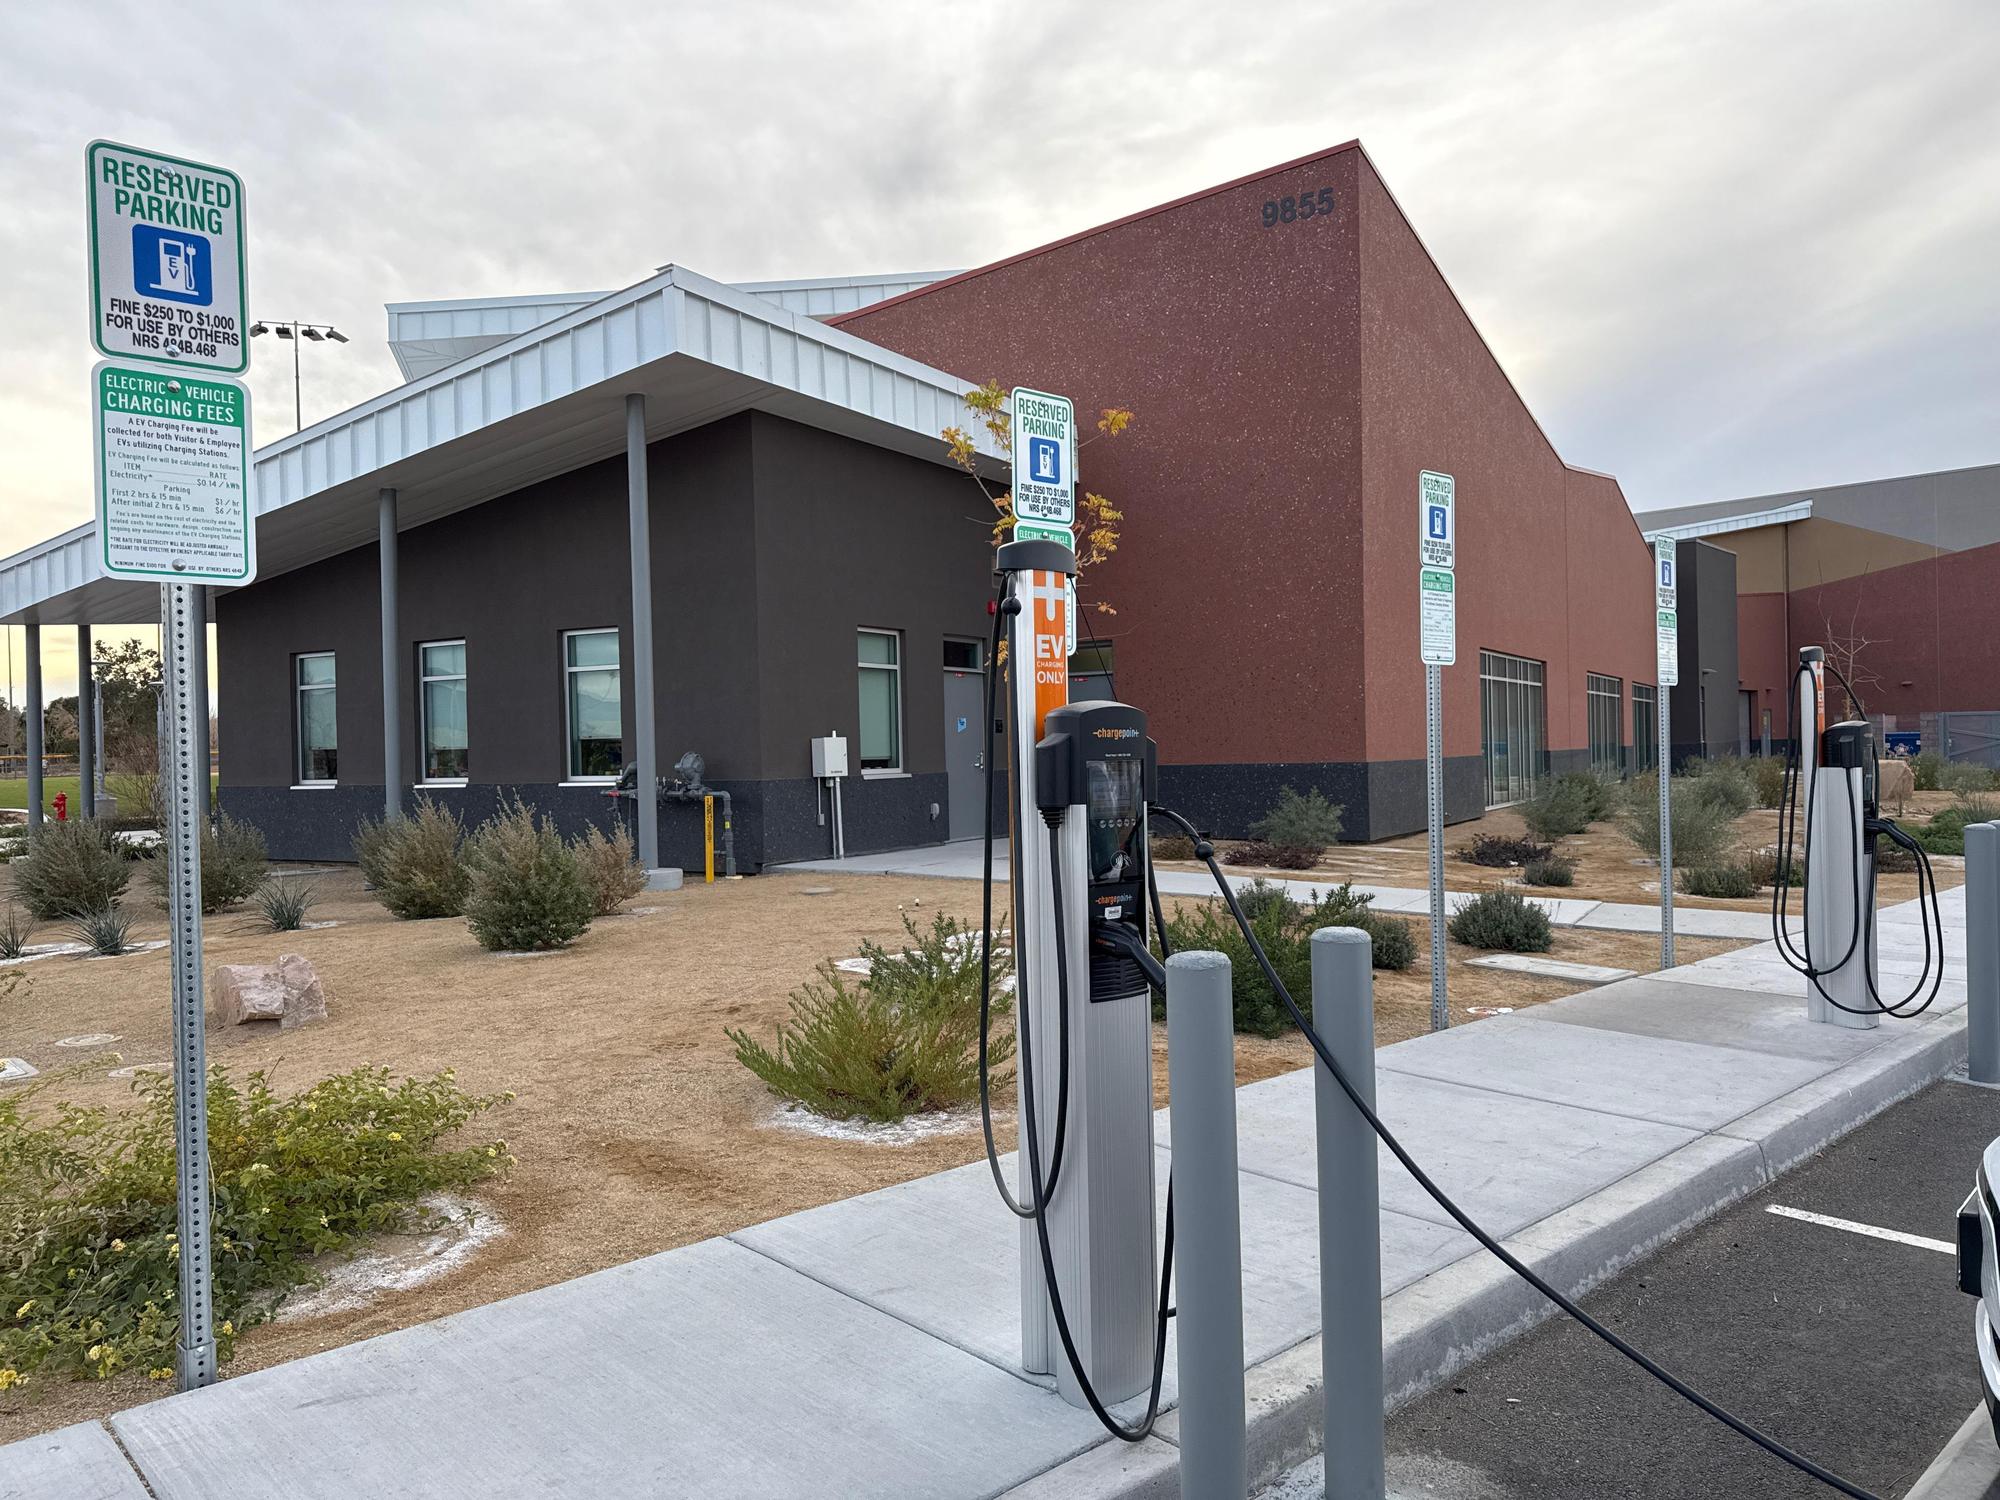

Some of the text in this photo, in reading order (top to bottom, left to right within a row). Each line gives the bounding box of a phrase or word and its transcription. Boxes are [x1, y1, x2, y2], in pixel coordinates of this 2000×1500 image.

[103, 157, 231, 208] RESERVED
[115, 189, 222, 235] PARKING
[1262, 187, 1334, 228] 9855
[111, 298, 234, 330] FINE $250 TO $1,000
[106, 313, 239, 346] FOR USE BY OTHERS
[133, 332, 159, 349] NRS
[106, 375, 235, 404] ELECTRIC VEHICLE
[107, 392, 234, 423] CHARGING FEES
[1018, 398, 1068, 423] RESERVED
[148, 420, 179, 432] Charging
[182, 424, 194, 432] Fee
[1023, 416, 1065, 439] PARKING
[108, 427, 140, 436] collected
[143, 430, 153, 438] for
[157, 432, 172, 440] both
[175, 434, 197, 443] Visitor
[207, 438, 240, 449] Employee
[117, 438, 130, 446] EVs
[133, 441, 162, 452] utilizing
[165, 444, 196, 456] Charging
[118, 452, 145, 461] Charging
[180, 460, 210, 468] calculated
[112, 488, 128, 496] First
[164, 485, 190, 495] Parking
[1019, 493, 1070, 508] FOR USE BY OTHERS
[1021, 483, 1033, 494] FINE
[1034, 485, 1045, 496] $250
[1046, 487, 1053, 496] TO
[1029, 503, 1039, 513] NRS
[1036, 634, 1064, 658] EV
[1037, 671, 1064, 684] ONLY
